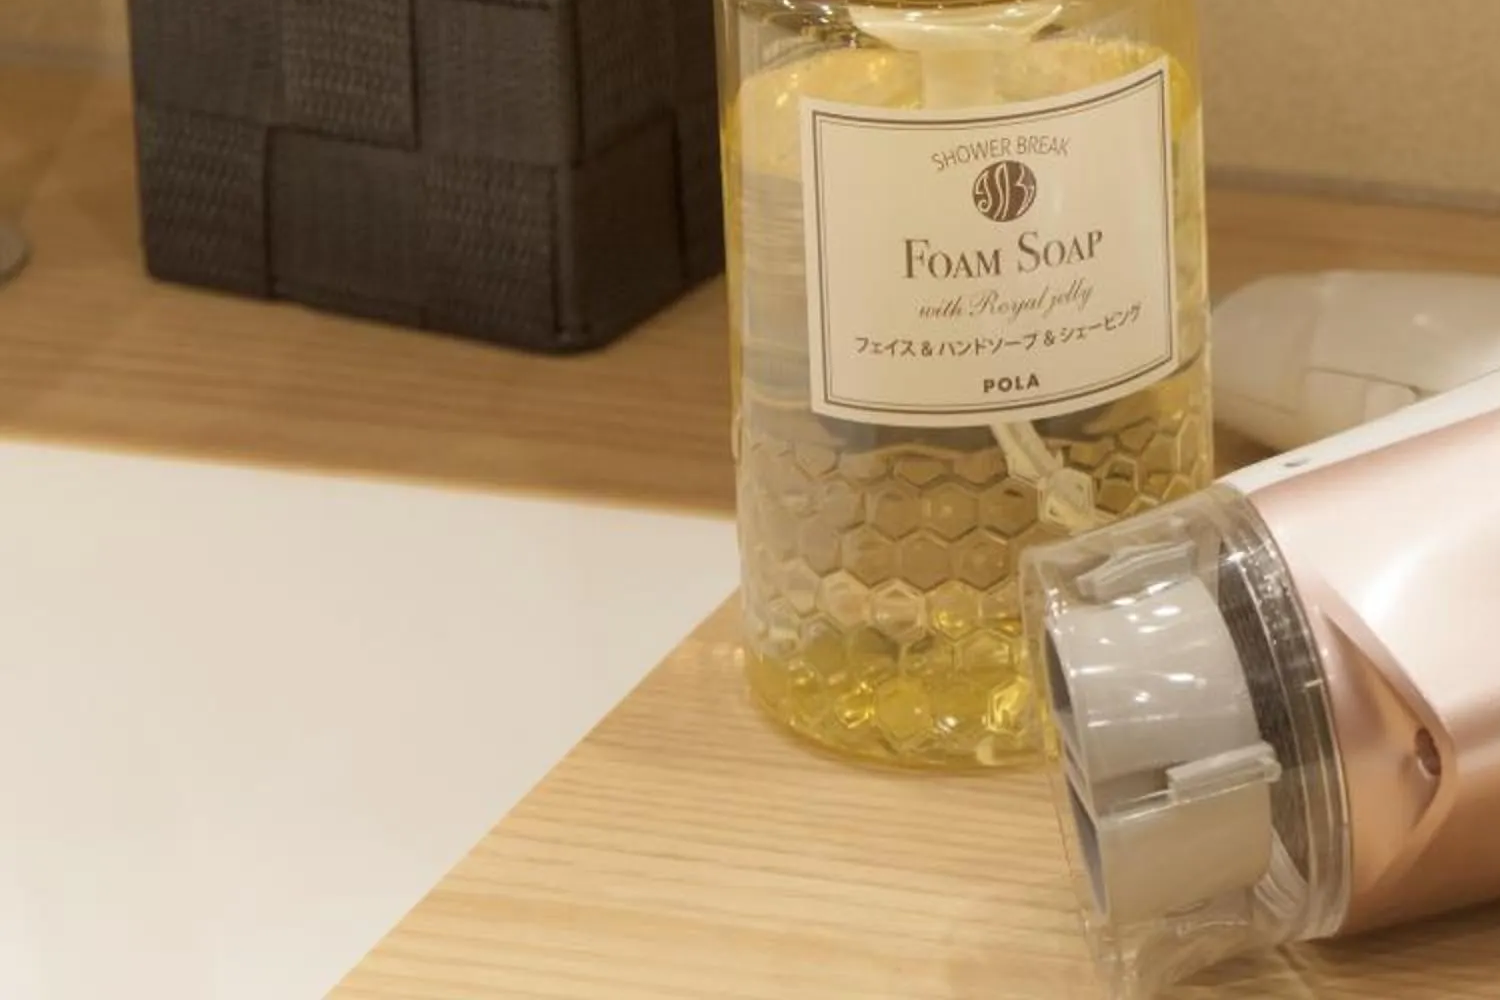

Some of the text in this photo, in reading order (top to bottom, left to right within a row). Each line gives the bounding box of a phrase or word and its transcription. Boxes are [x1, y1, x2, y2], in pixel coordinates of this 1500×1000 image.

[930, 134, 1070, 171] SHOWER BREAK
[902, 230, 1104, 280] FOAM SOAP
[919, 278, 1093, 321] with Royal jelly
[982, 373, 1041, 394] POLA
